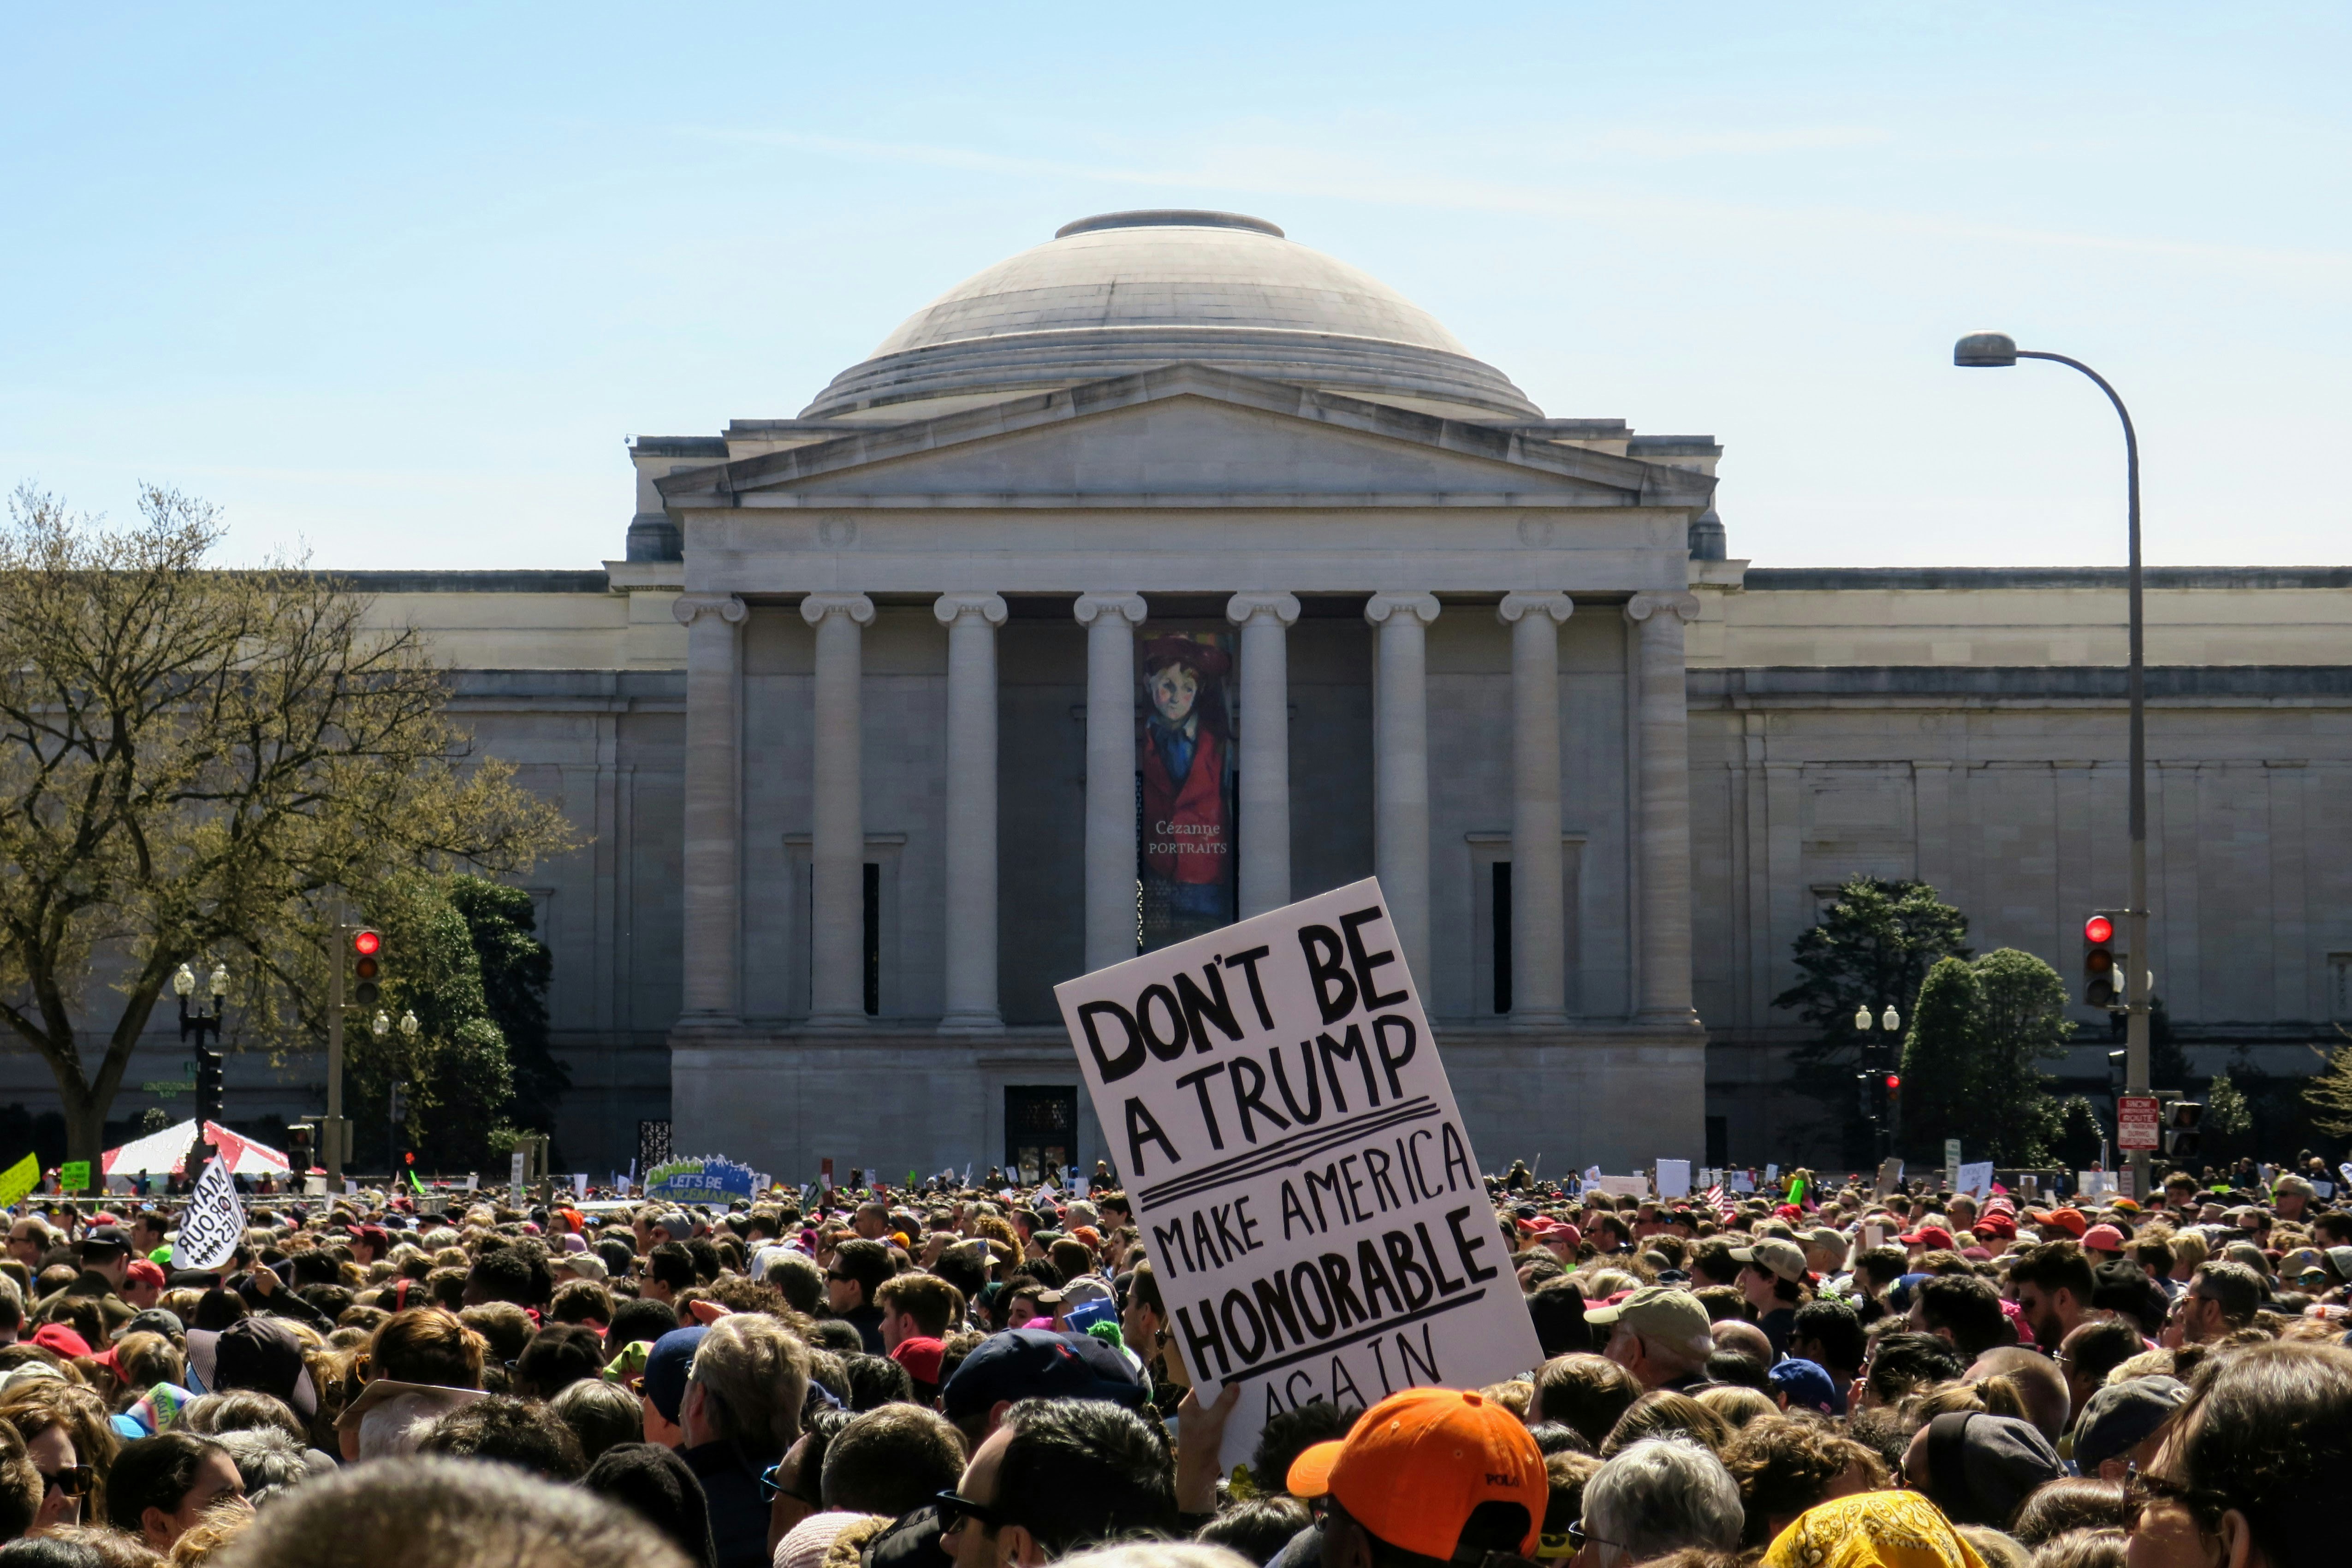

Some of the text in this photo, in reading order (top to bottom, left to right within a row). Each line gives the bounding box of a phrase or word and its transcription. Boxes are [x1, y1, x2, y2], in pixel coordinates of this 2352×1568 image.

[1149, 843, 1227, 854] PORTRAITS
[1156, 820, 1220, 834] Cézanne
[1078, 906, 1409, 1084] DON'T BE
[1125, 1015, 1416, 1176] A TRUMP
[670, 1174, 723, 1190] LET'S BE
[1152, 1122, 1475, 1279] MAKE AMERICA
[1176, 1206, 1497, 1382] HONORABLE
[1266, 1323, 1442, 1424] AGAIN
[1485, 1474, 1520, 1487] POLO
